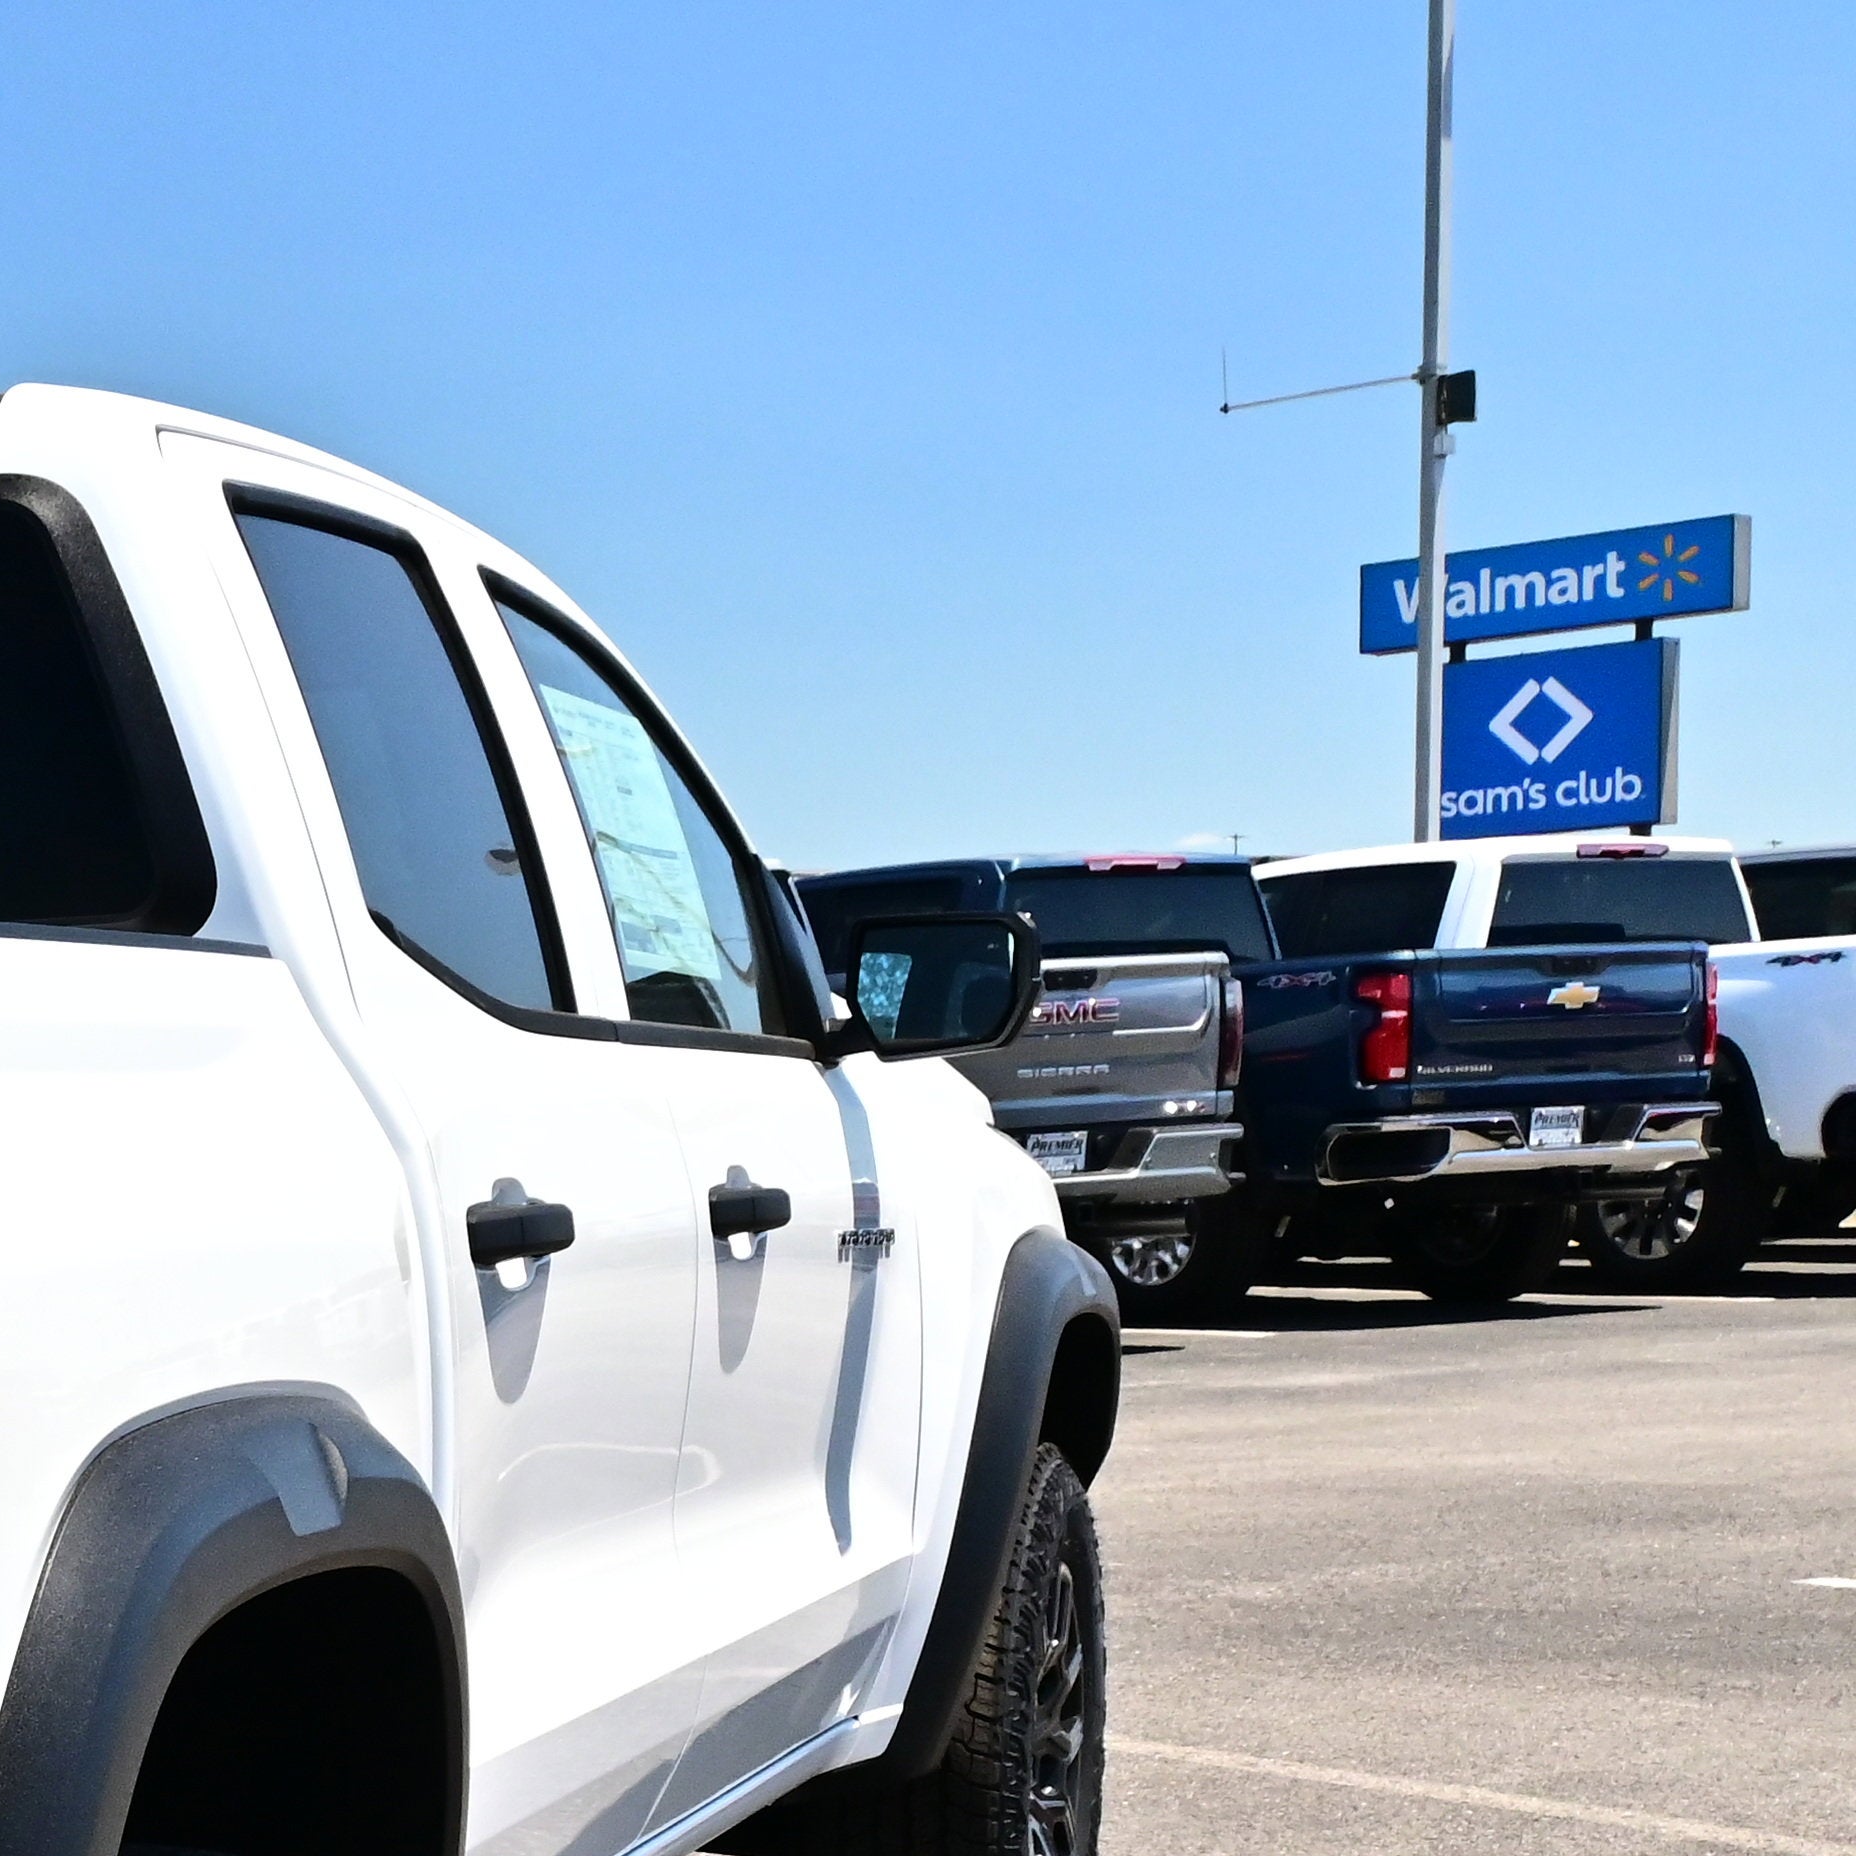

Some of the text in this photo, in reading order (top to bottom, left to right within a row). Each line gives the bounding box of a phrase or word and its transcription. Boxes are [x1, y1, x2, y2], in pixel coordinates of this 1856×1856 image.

[1441, 767, 1642, 818] sam's club
[1029, 998, 1120, 1026] GMC
[1017, 1064, 1110, 1078] SIERRA
